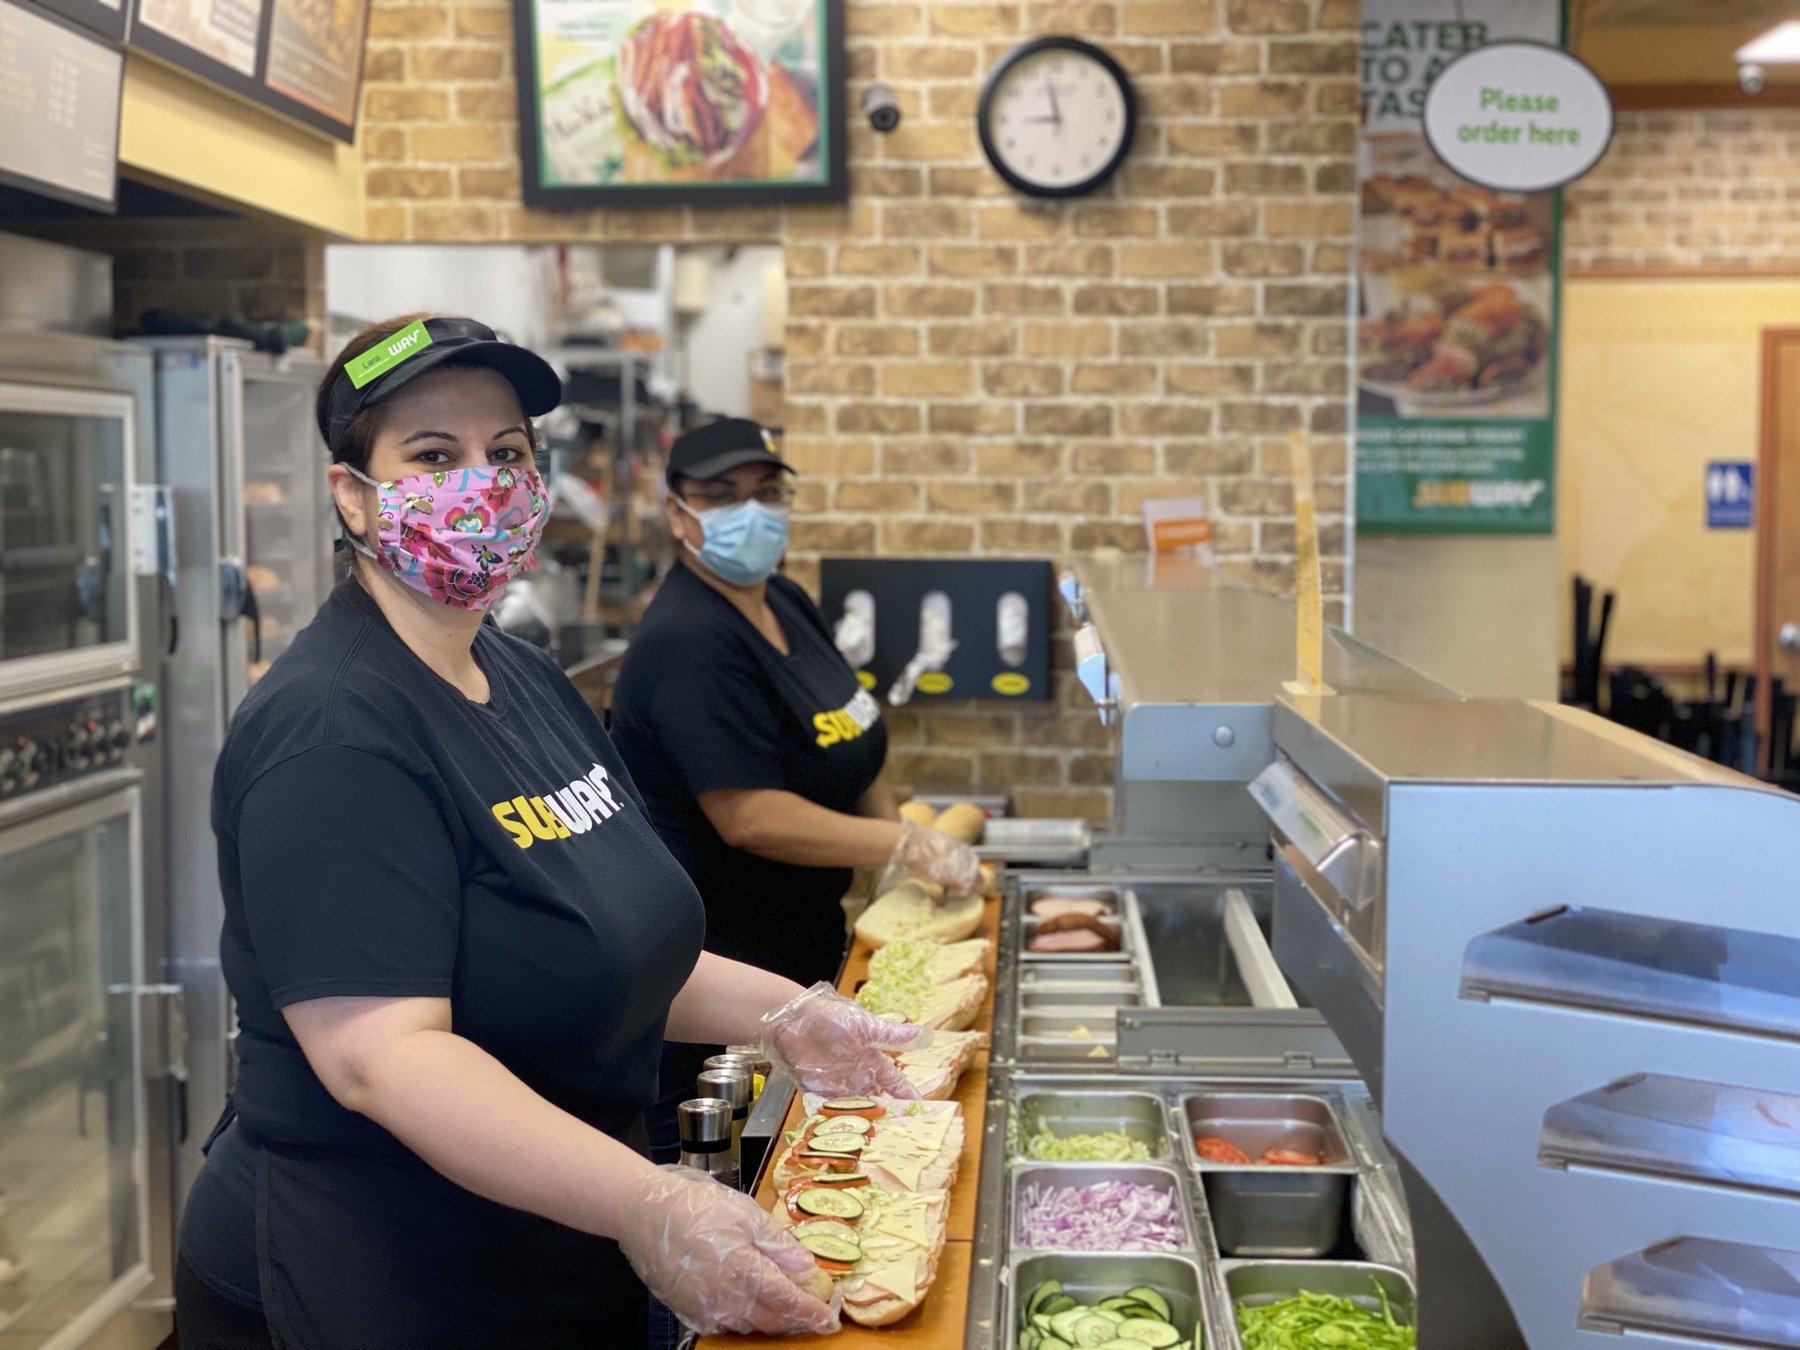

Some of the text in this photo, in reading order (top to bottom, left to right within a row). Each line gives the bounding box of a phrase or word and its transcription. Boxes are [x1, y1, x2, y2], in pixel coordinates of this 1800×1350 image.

[1480, 87, 1559, 112] Please
[1457, 121, 1579, 144] order here
[388, 329, 420, 356] WAY
[361, 355, 381, 369] Lara
[492, 763, 622, 849] SUBWAY
